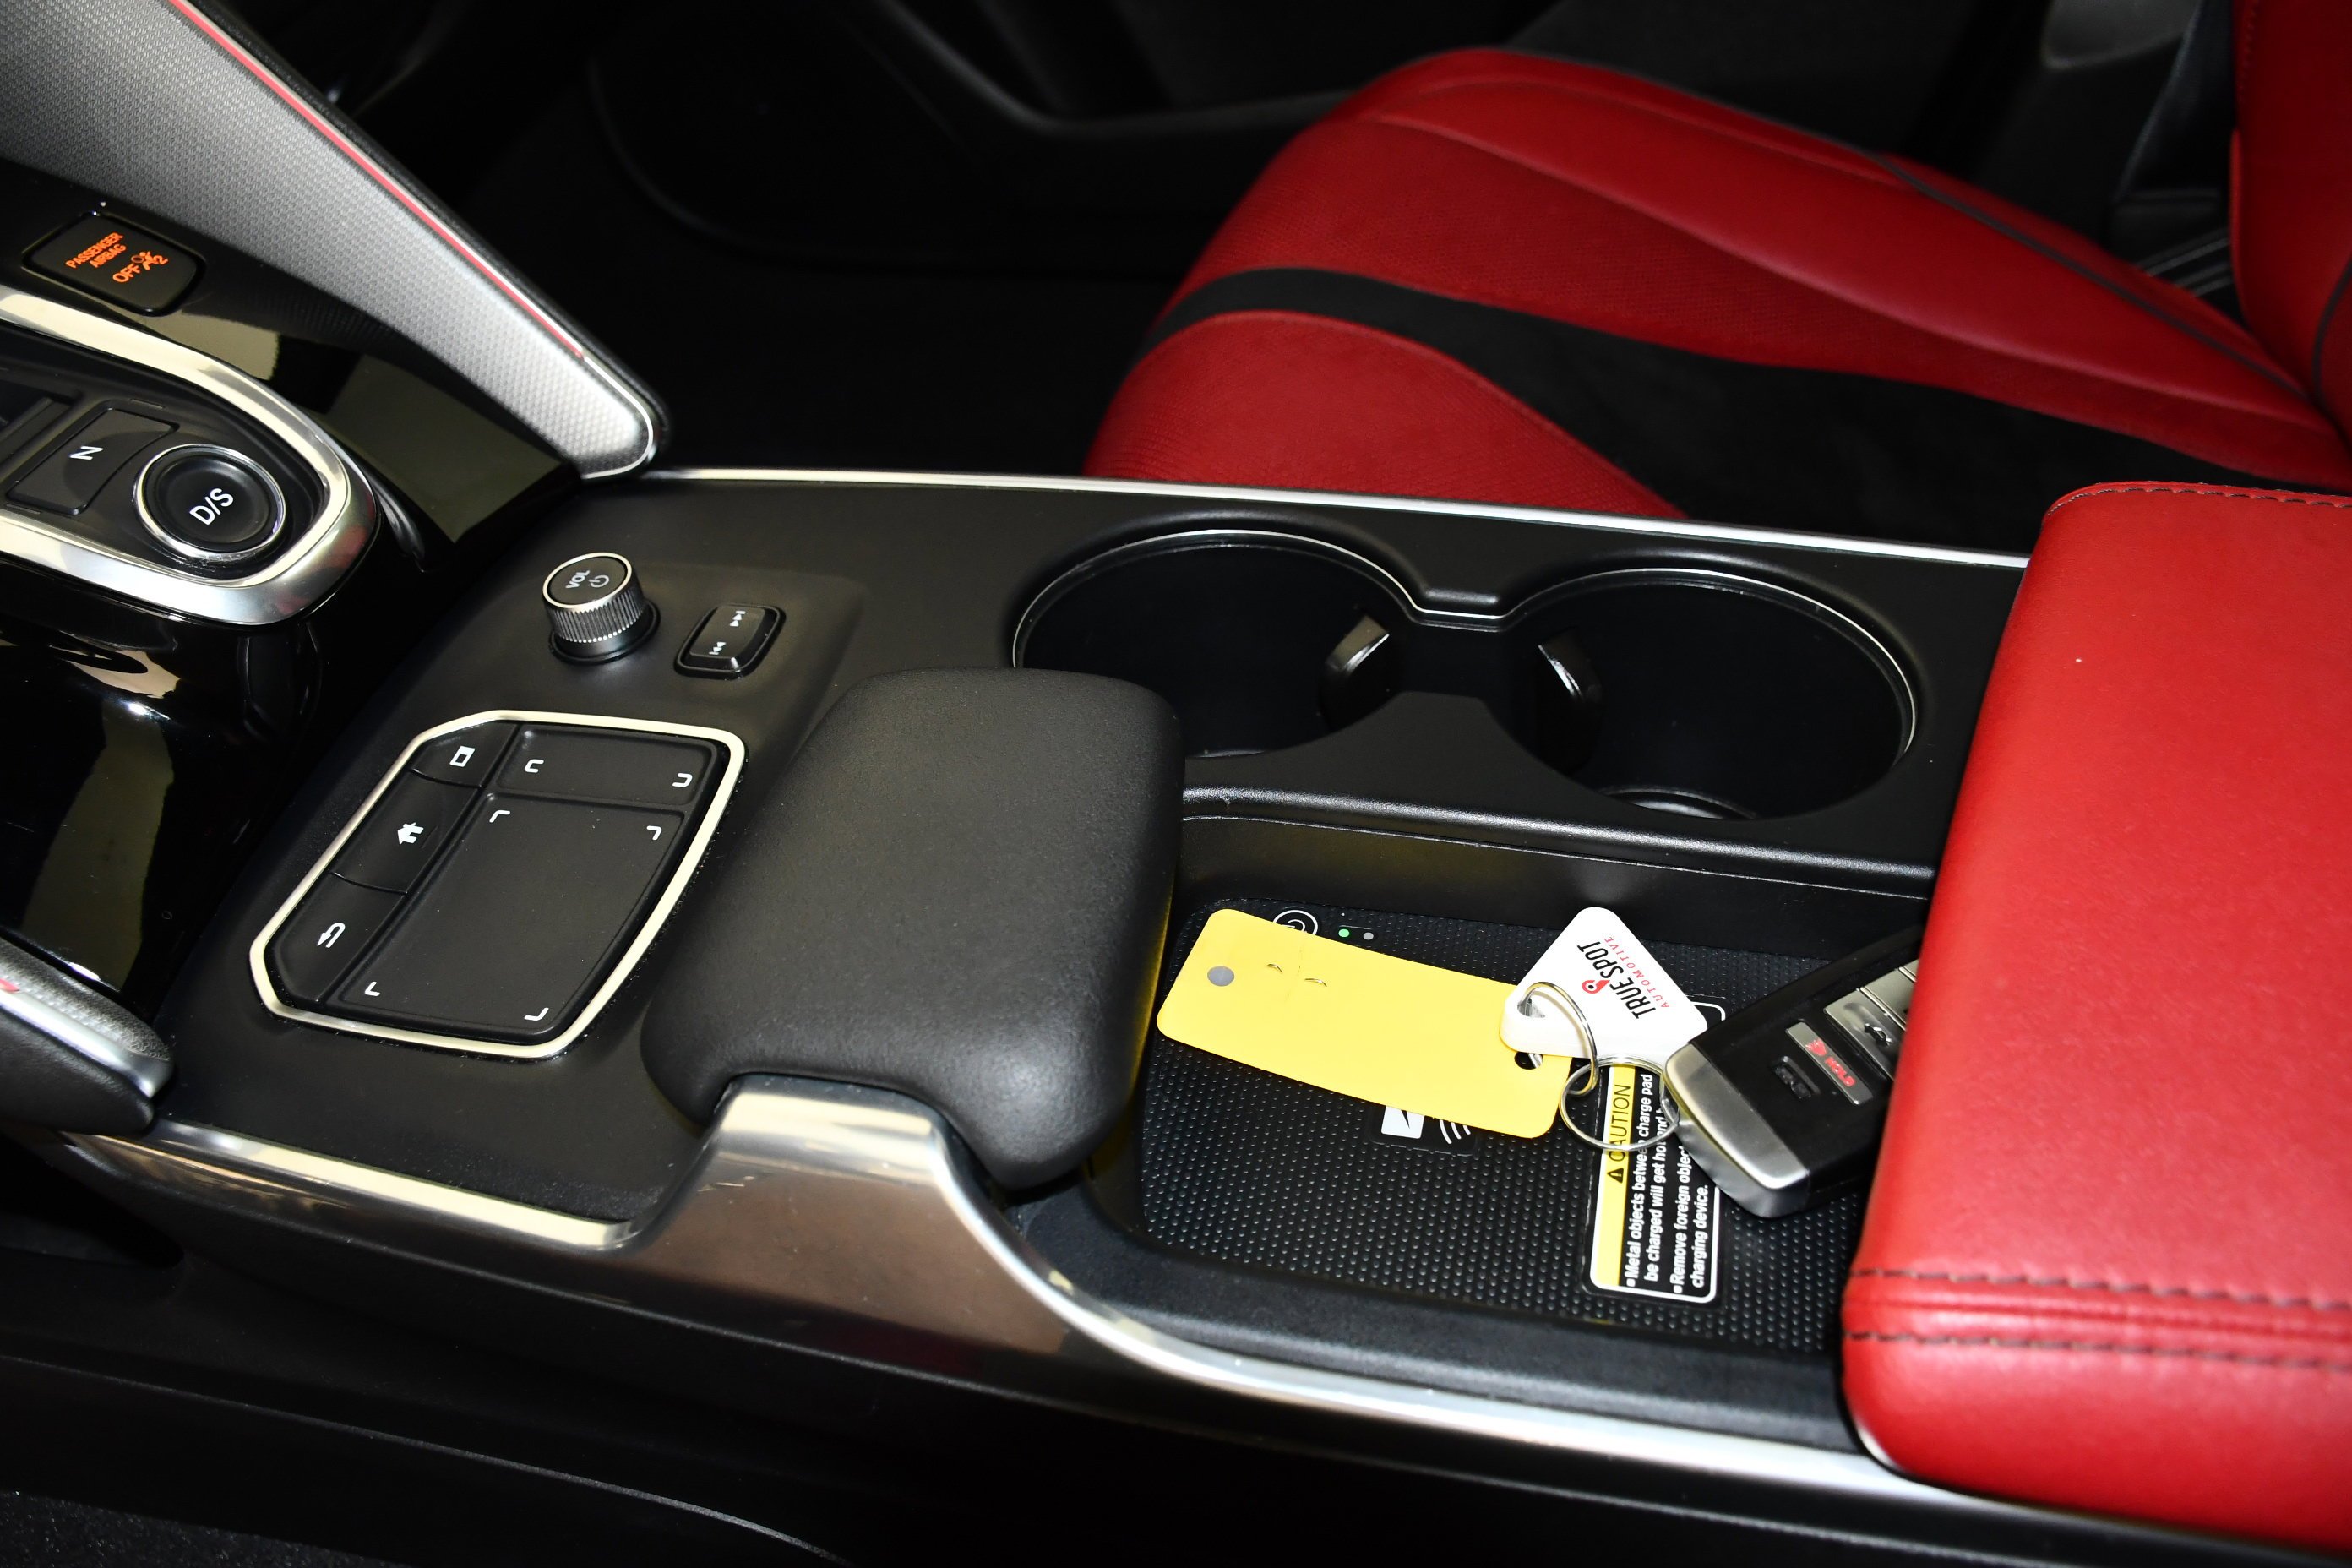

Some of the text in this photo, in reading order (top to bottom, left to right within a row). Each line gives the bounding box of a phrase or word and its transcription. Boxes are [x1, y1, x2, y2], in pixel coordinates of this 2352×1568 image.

[65, 232, 123, 269] PASSENGER
[90, 243, 127, 268] AIRBAG
[112, 263, 140, 282] OFF
[68, 445, 104, 460] N
[188, 487, 234, 525] D/S
[565, 570, 591, 589] VOL
[1576, 941, 1656, 1019] TRUE SPOT
[1603, 936, 1669, 1008] AUTOMOTIVE
[1640, 1074, 1653, 1096] pad
[1636, 1097, 1653, 1137] charge
[1652, 1162, 1667, 1184] get
[1650, 1184, 1664, 1207] will
[1674, 1184, 1691, 1230] foreign
[1629, 1192, 1645, 1239] objects
[1646, 1209, 1664, 1262] charged
[1690, 1184, 1709, 1289] charging device.
[1624, 1240, 1642, 1279] Metal
[1644, 1263, 1659, 1282] be
[1669, 1232, 1688, 1286] Remove
